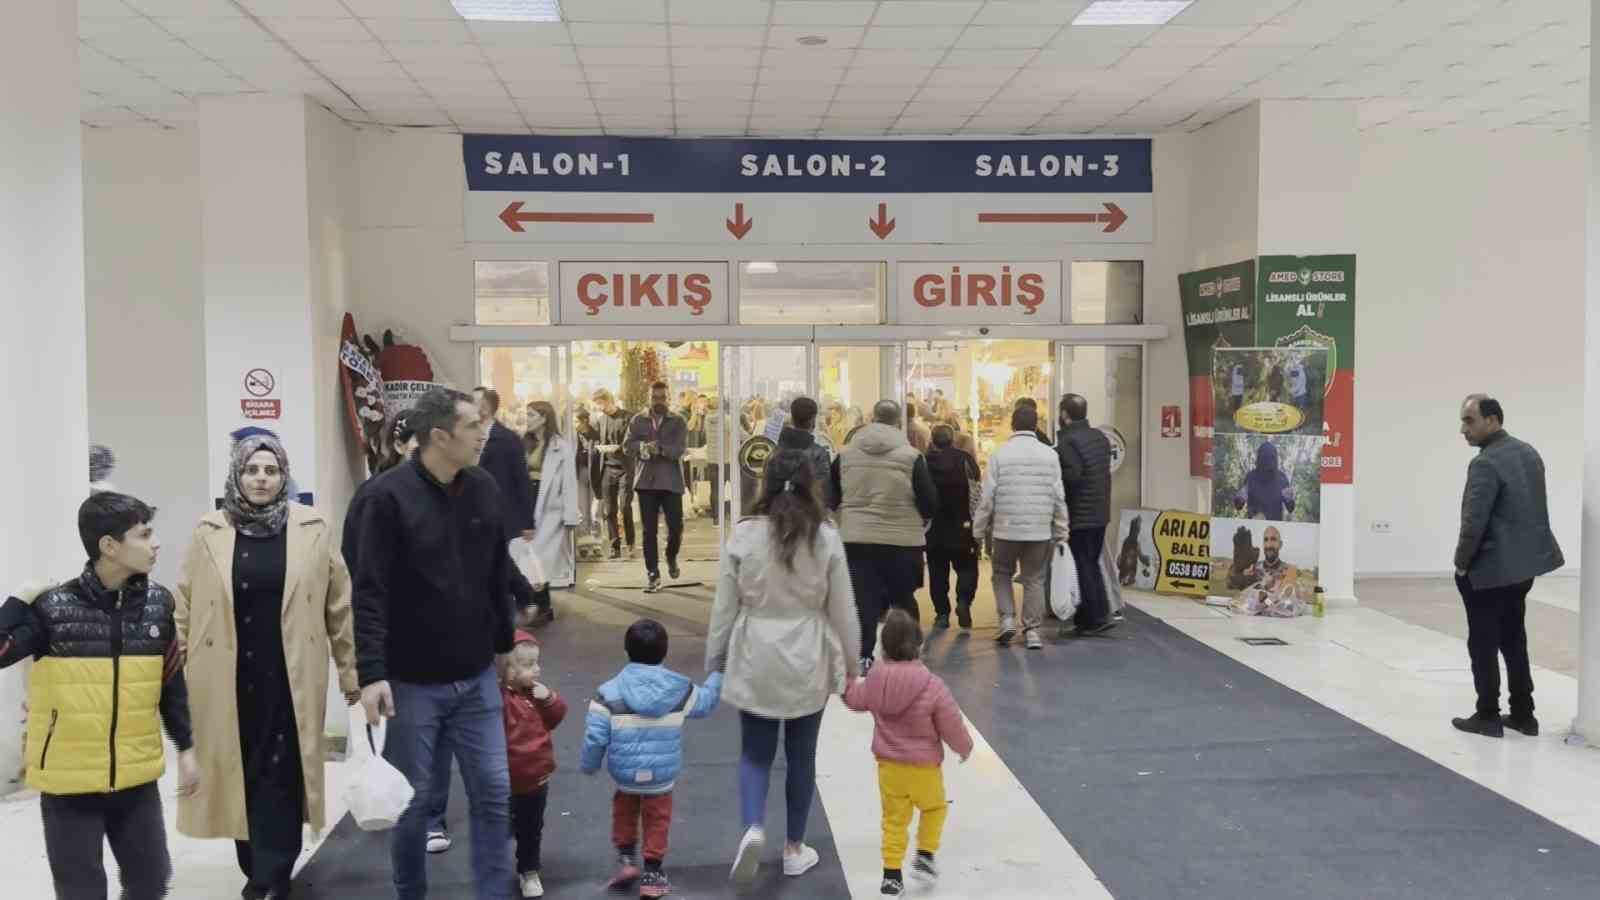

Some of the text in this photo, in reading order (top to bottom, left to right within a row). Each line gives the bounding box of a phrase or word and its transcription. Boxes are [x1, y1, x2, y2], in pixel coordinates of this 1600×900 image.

[485, 152, 630, 176] SALON-1
[741, 154, 886, 177] SALON-2
[976, 154, 1119, 177] SALON-3
[577, 273, 712, 316] ÇIKIŞ
[913, 265, 1045, 315] GİRİŞ
[1160, 518, 1185, 538] ARI
[1171, 542, 1194, 556] BAL
